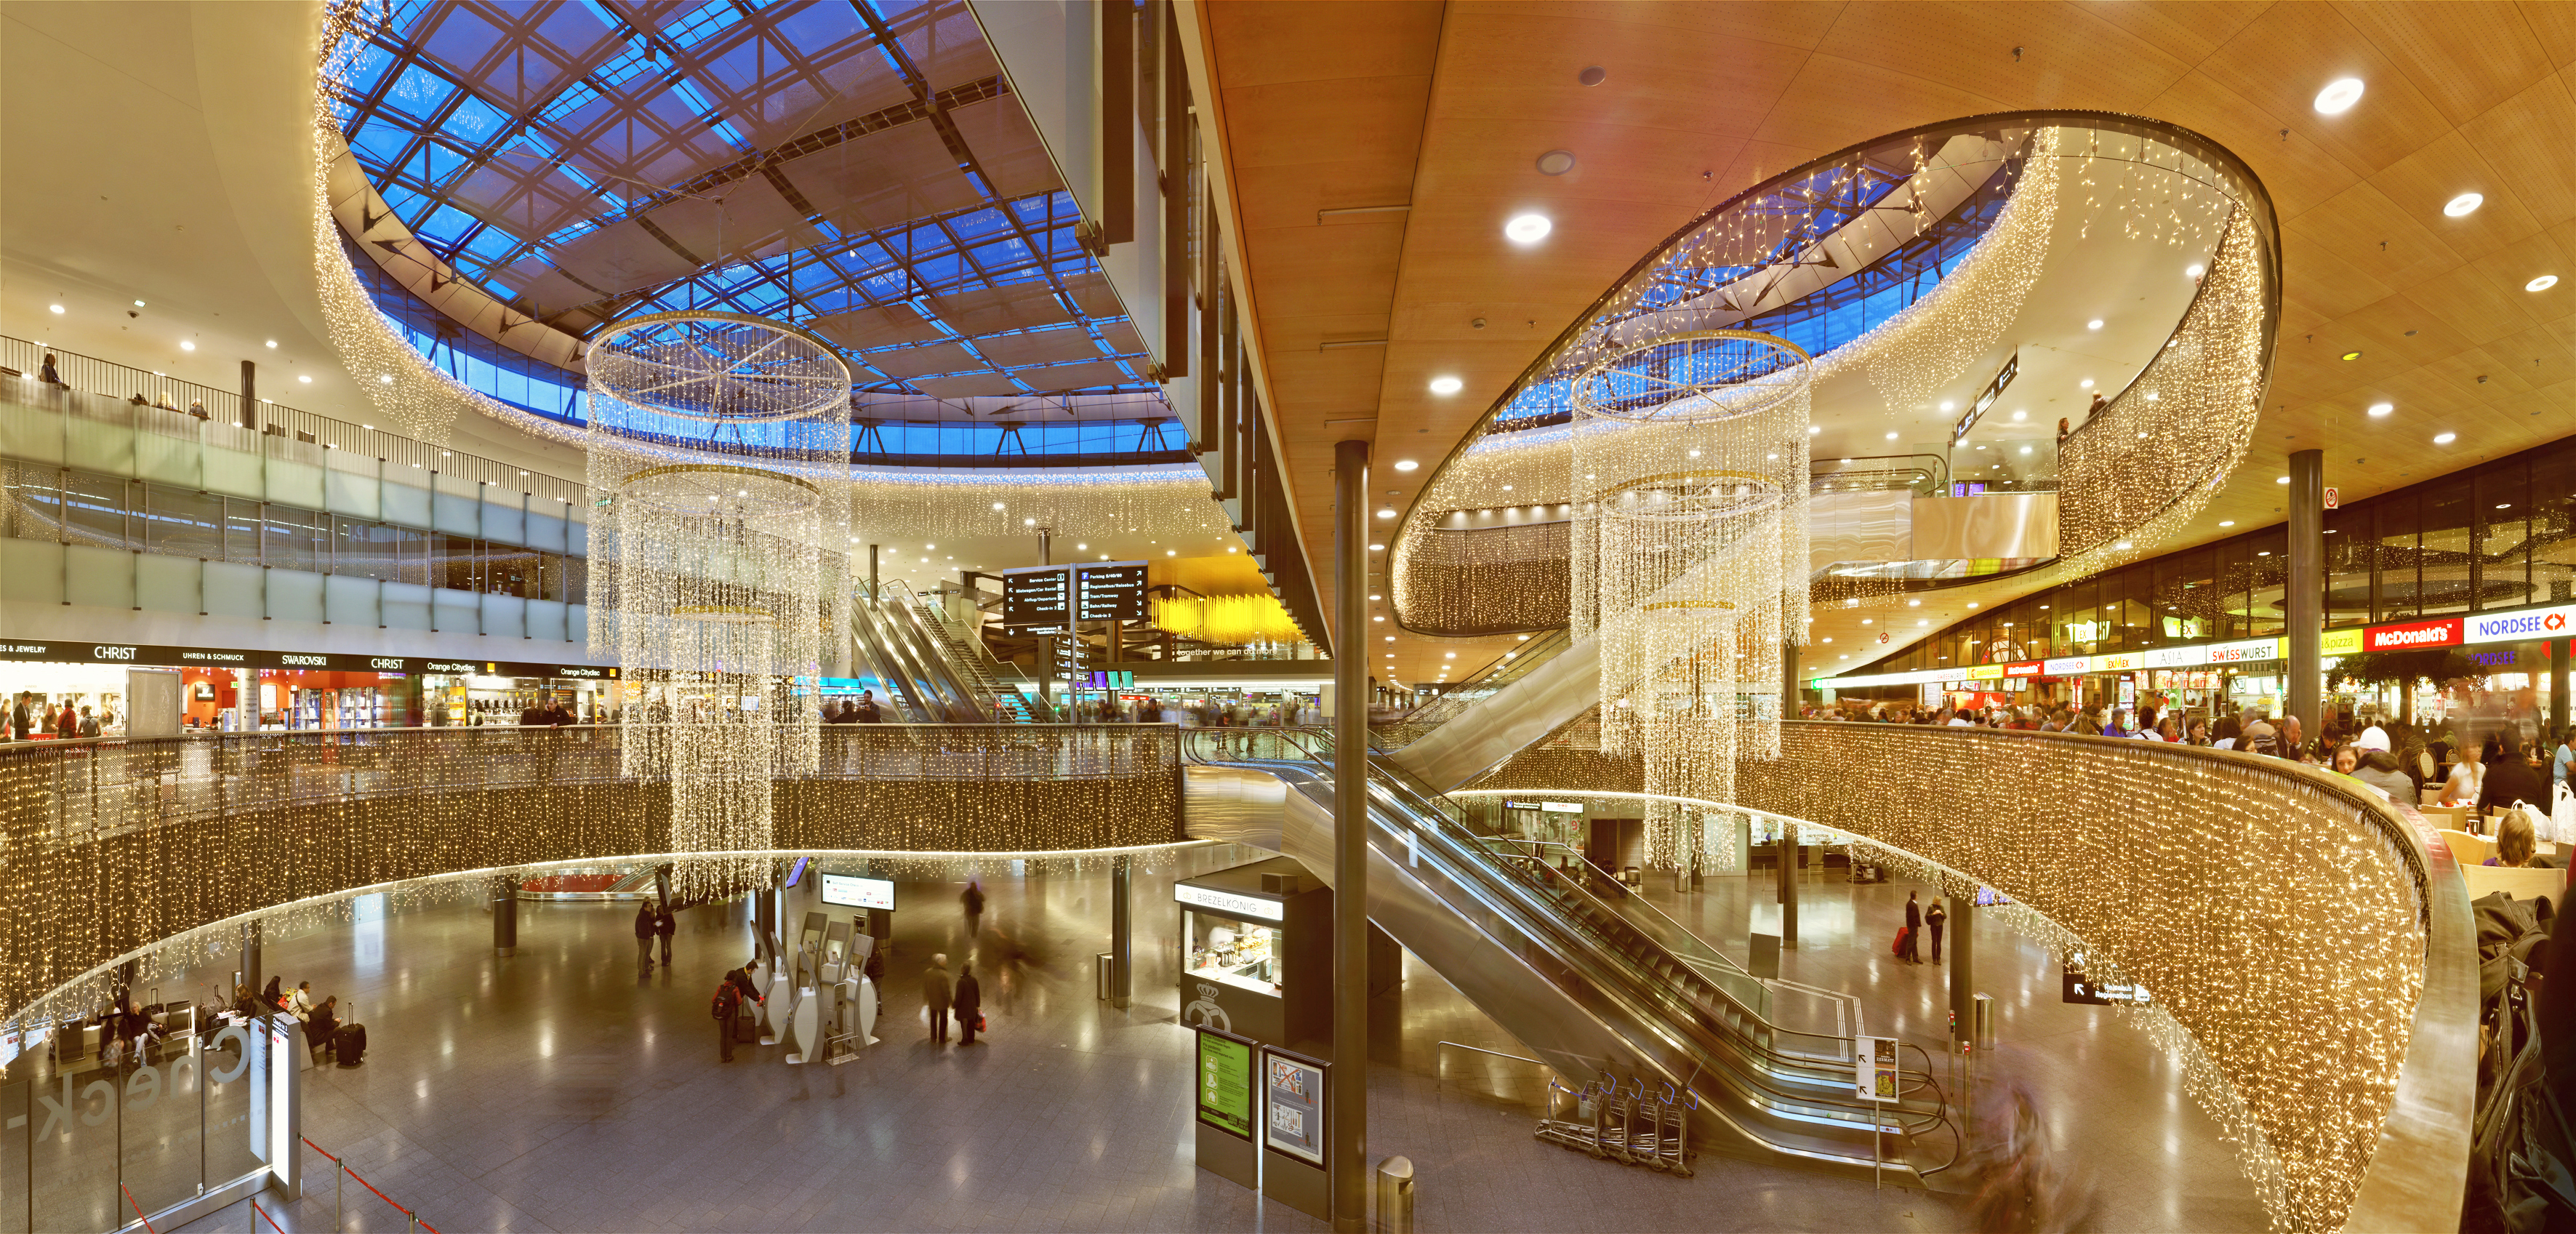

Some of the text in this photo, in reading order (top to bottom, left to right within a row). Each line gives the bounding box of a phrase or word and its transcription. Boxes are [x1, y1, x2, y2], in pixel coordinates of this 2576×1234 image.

[2479, 616, 2541, 636] NORDSEE
[2375, 627, 2448, 646] McDonald's
[15, 645, 46, 654] JEWELRY
[95, 646, 137, 660] CHRIST
[1178, 648, 1211, 657] together
[2212, 646, 2272, 662] SWISSWURST
[282, 654, 326, 666] SWAROVSKI
[371, 658, 404, 670] CHRIST
[2160, 651, 2183, 665] ASIA
[428, 662, 476, 673] Orange Citydisc
[2050, 661, 2074, 671] NORDSEE
[561, 668, 579, 677] Orange
[1197, 893, 1257, 913] BREZELKÖNIG
[273, 1017, 285, 1030] Check-in
